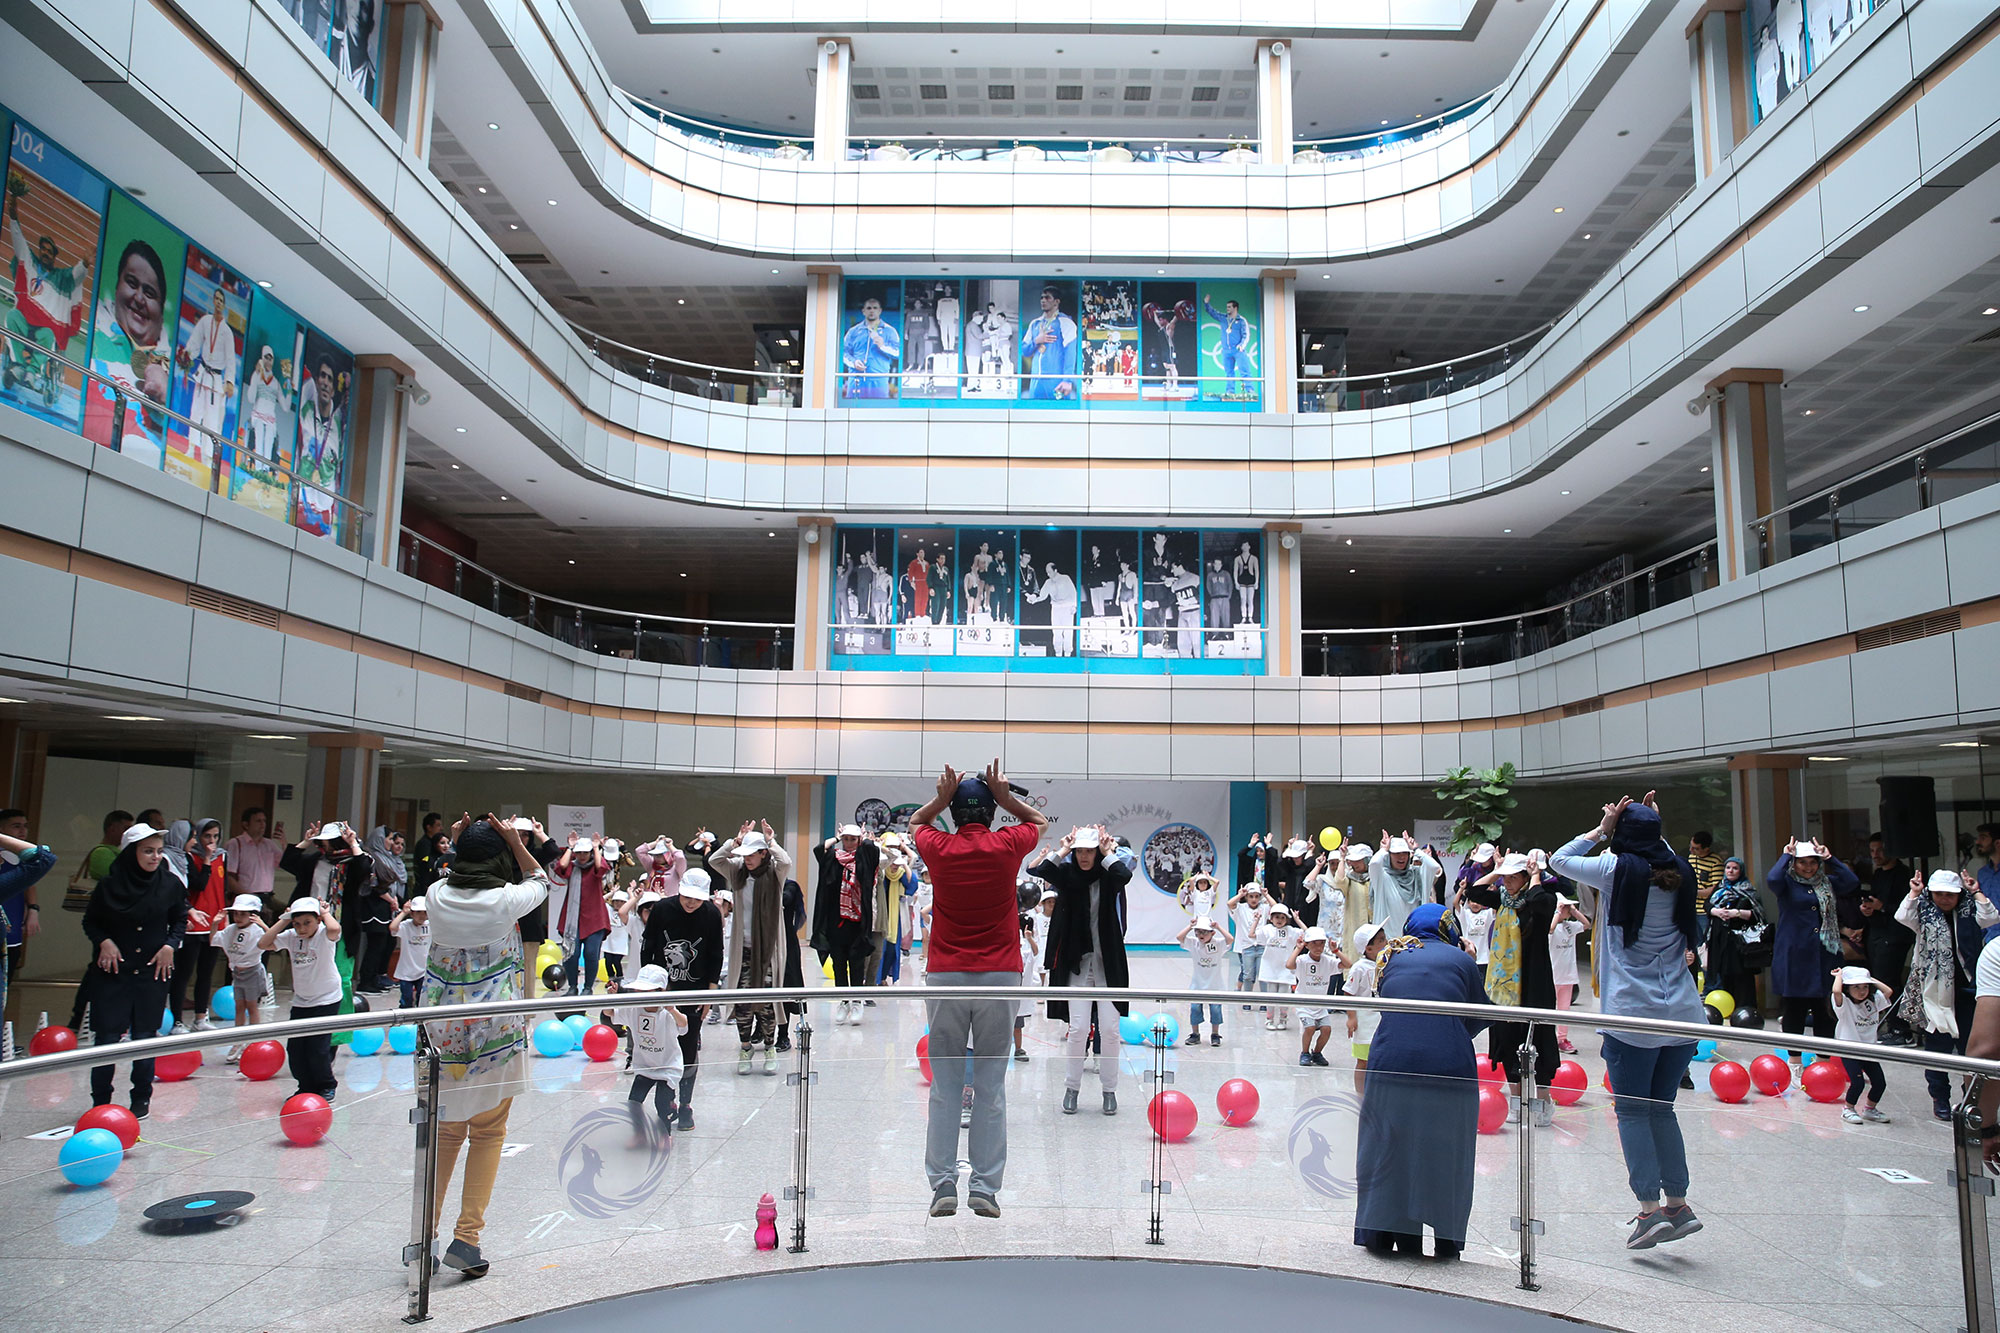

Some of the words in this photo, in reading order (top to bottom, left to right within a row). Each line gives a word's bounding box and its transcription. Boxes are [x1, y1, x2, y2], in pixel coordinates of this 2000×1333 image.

[958, 629, 963, 640] 2
[985, 628, 992, 642] 3
[869, 636, 876, 645] 3
[1121, 640, 1129, 653] 3
[1218, 644, 1225, 656] 2
[237, 932, 245, 943] 6
[1206, 943, 1216, 952] 14
[1310, 964, 1317, 974] 9
[1864, 1001, 1872, 1012] 5
[642, 1018, 650, 1031] 2
